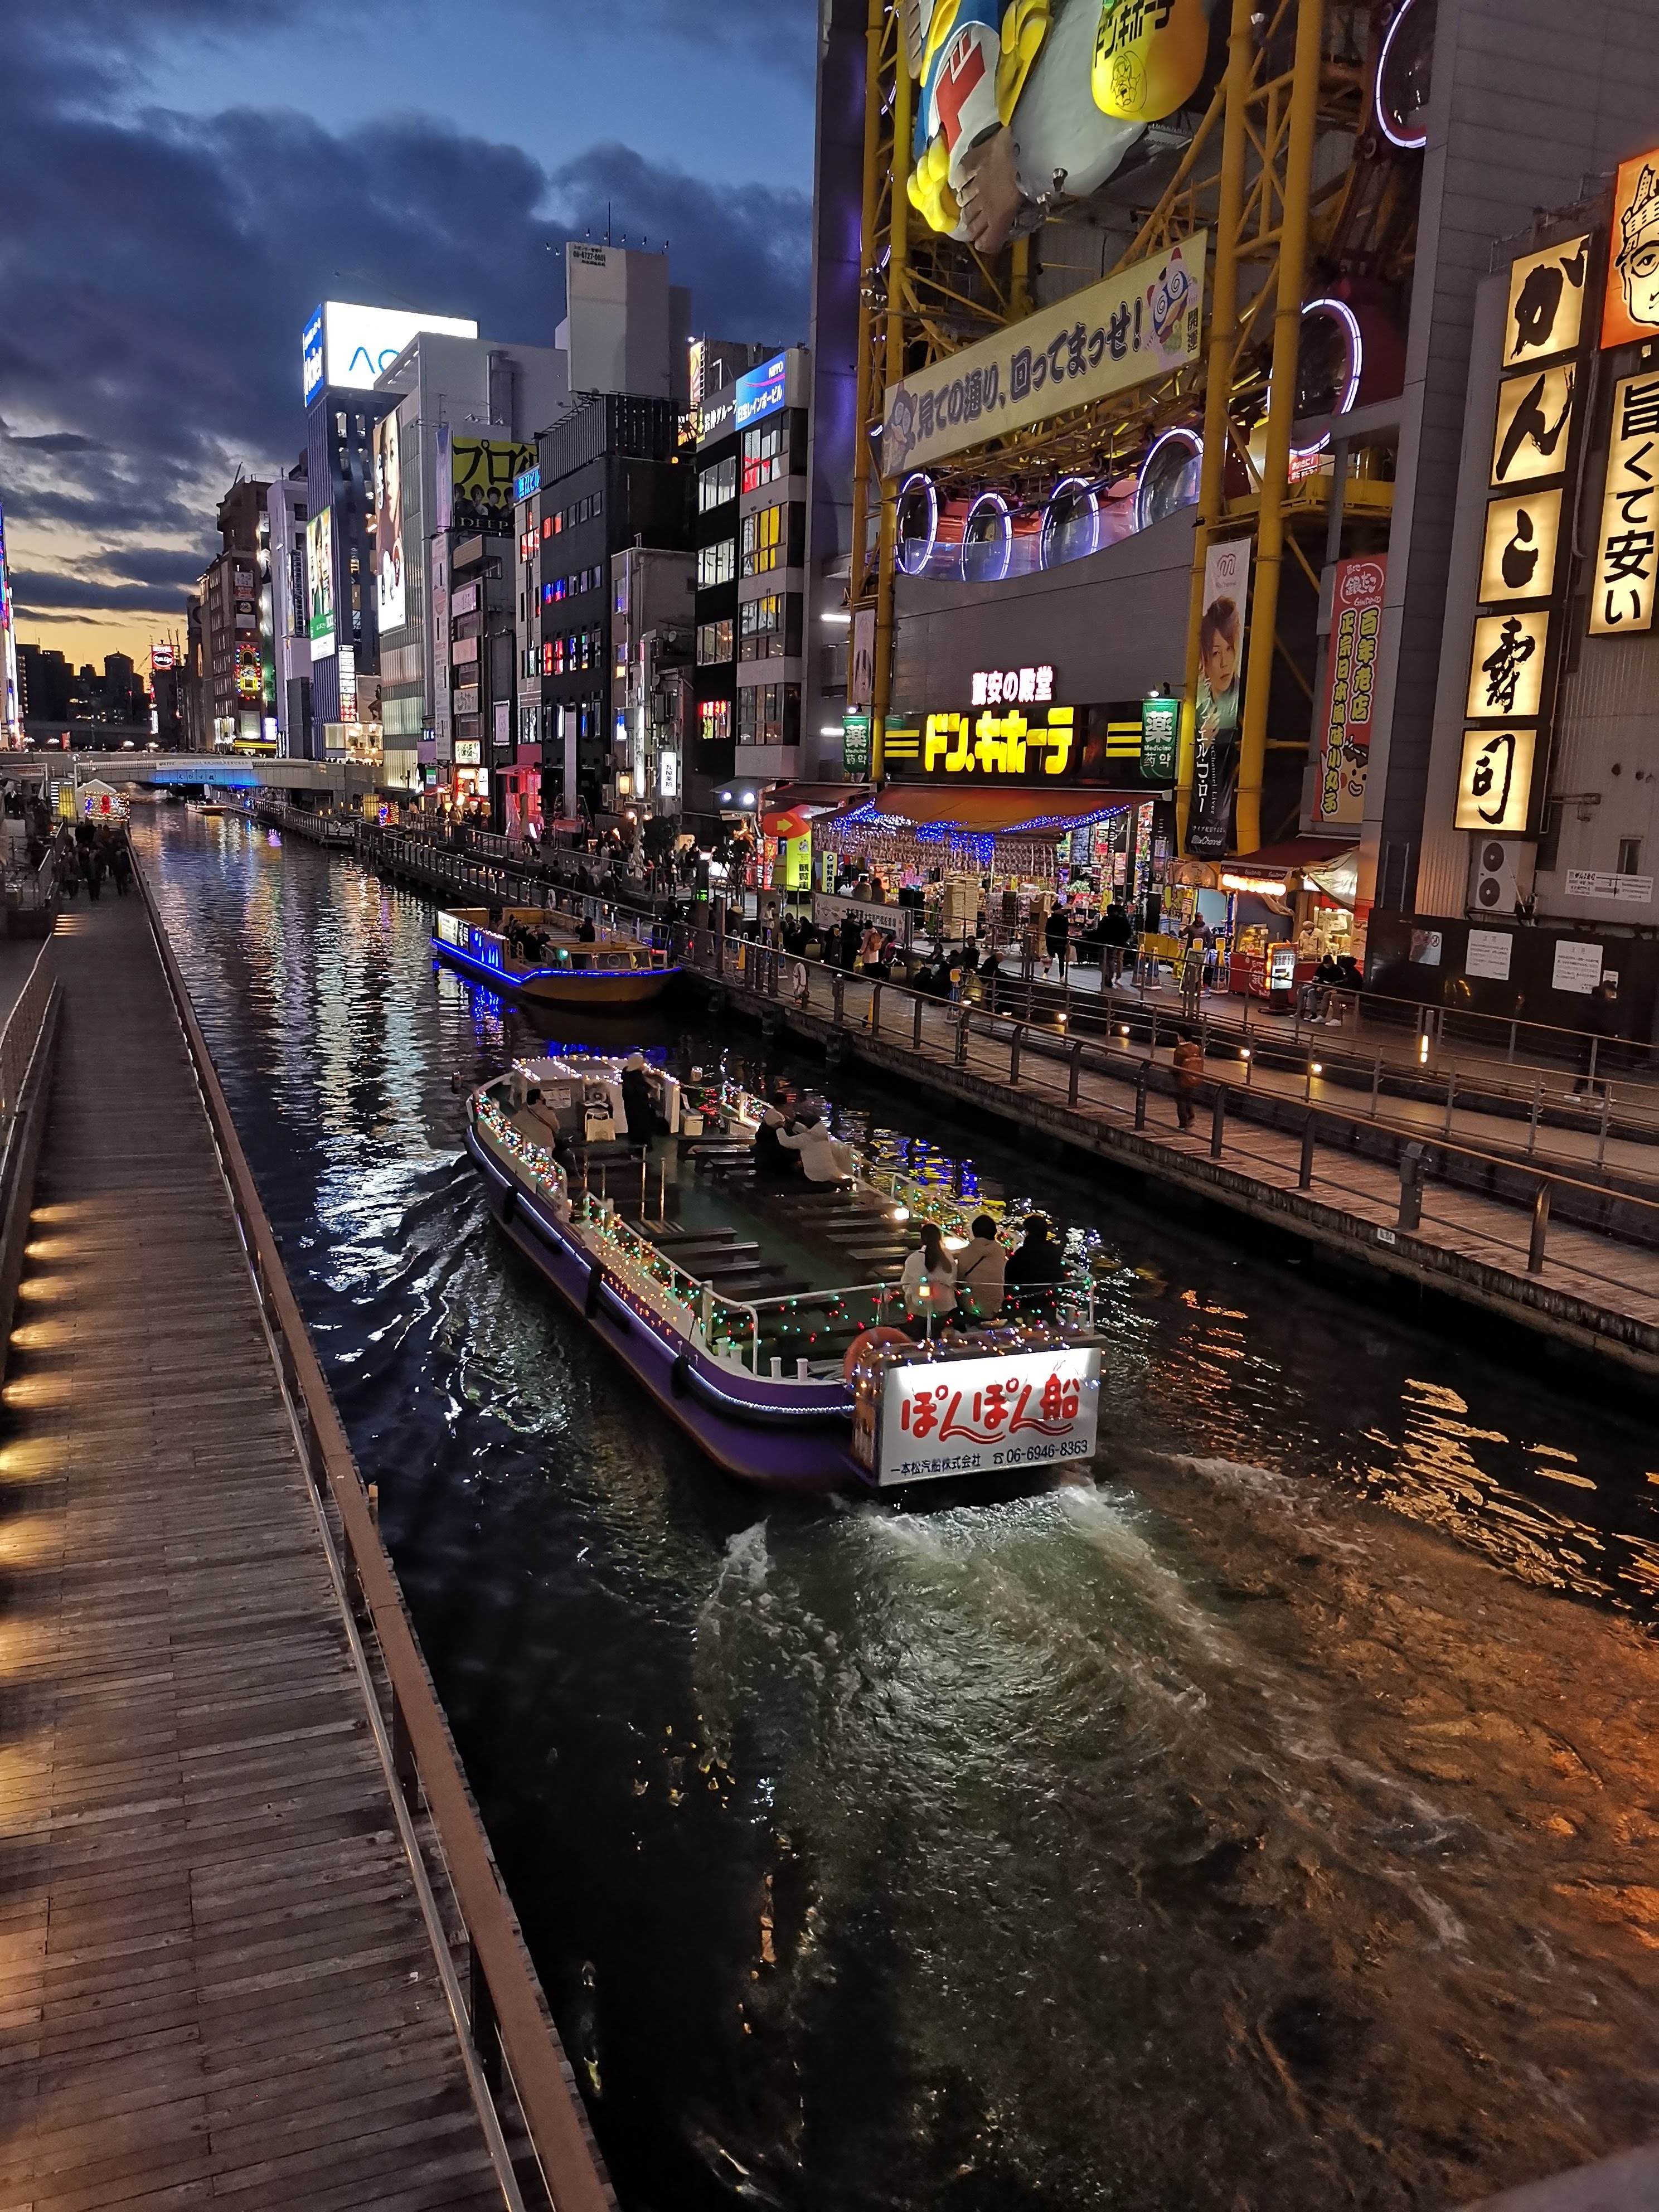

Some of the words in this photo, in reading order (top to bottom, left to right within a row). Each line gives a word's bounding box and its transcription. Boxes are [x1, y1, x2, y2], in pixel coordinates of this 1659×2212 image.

[1187, 308, 1199, 353] 開運
[1603, 385, 1659, 625] 旨くて安い
[460, 517, 509, 530] DEEP
[1350, 605, 1381, 723] 百年老店
[846, 724, 867, 748] 薬
[1145, 710, 1173, 743] 薬
[1159, 753, 1171, 768] 약
[901, 1372, 1080, 1444] ぽんぽん船
[1007, 1439, 1088, 1463] 06-6946-8363
